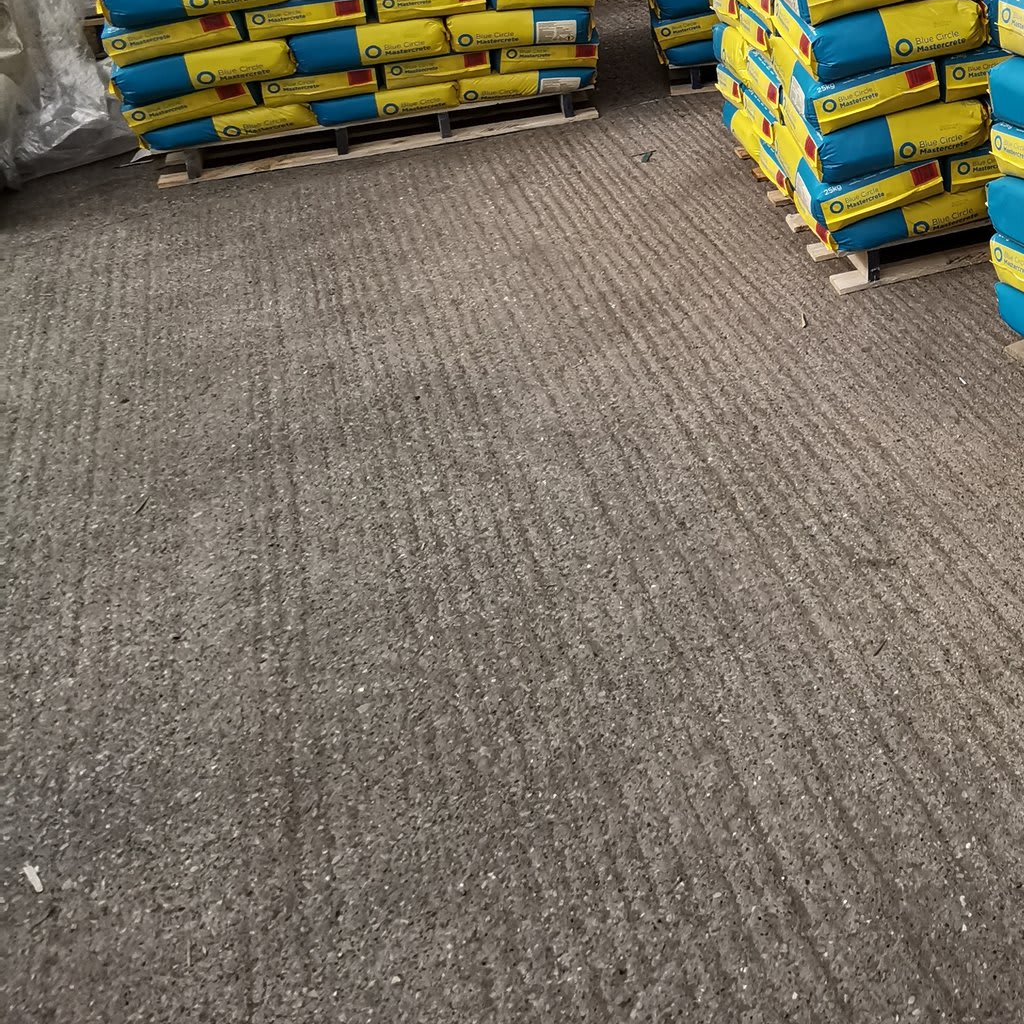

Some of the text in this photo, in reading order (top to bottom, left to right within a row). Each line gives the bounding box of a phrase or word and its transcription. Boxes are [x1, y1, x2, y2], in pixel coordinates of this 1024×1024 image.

[916, 30, 959, 45] Blue Circle
[916, 38, 966, 53] Mastercrete
